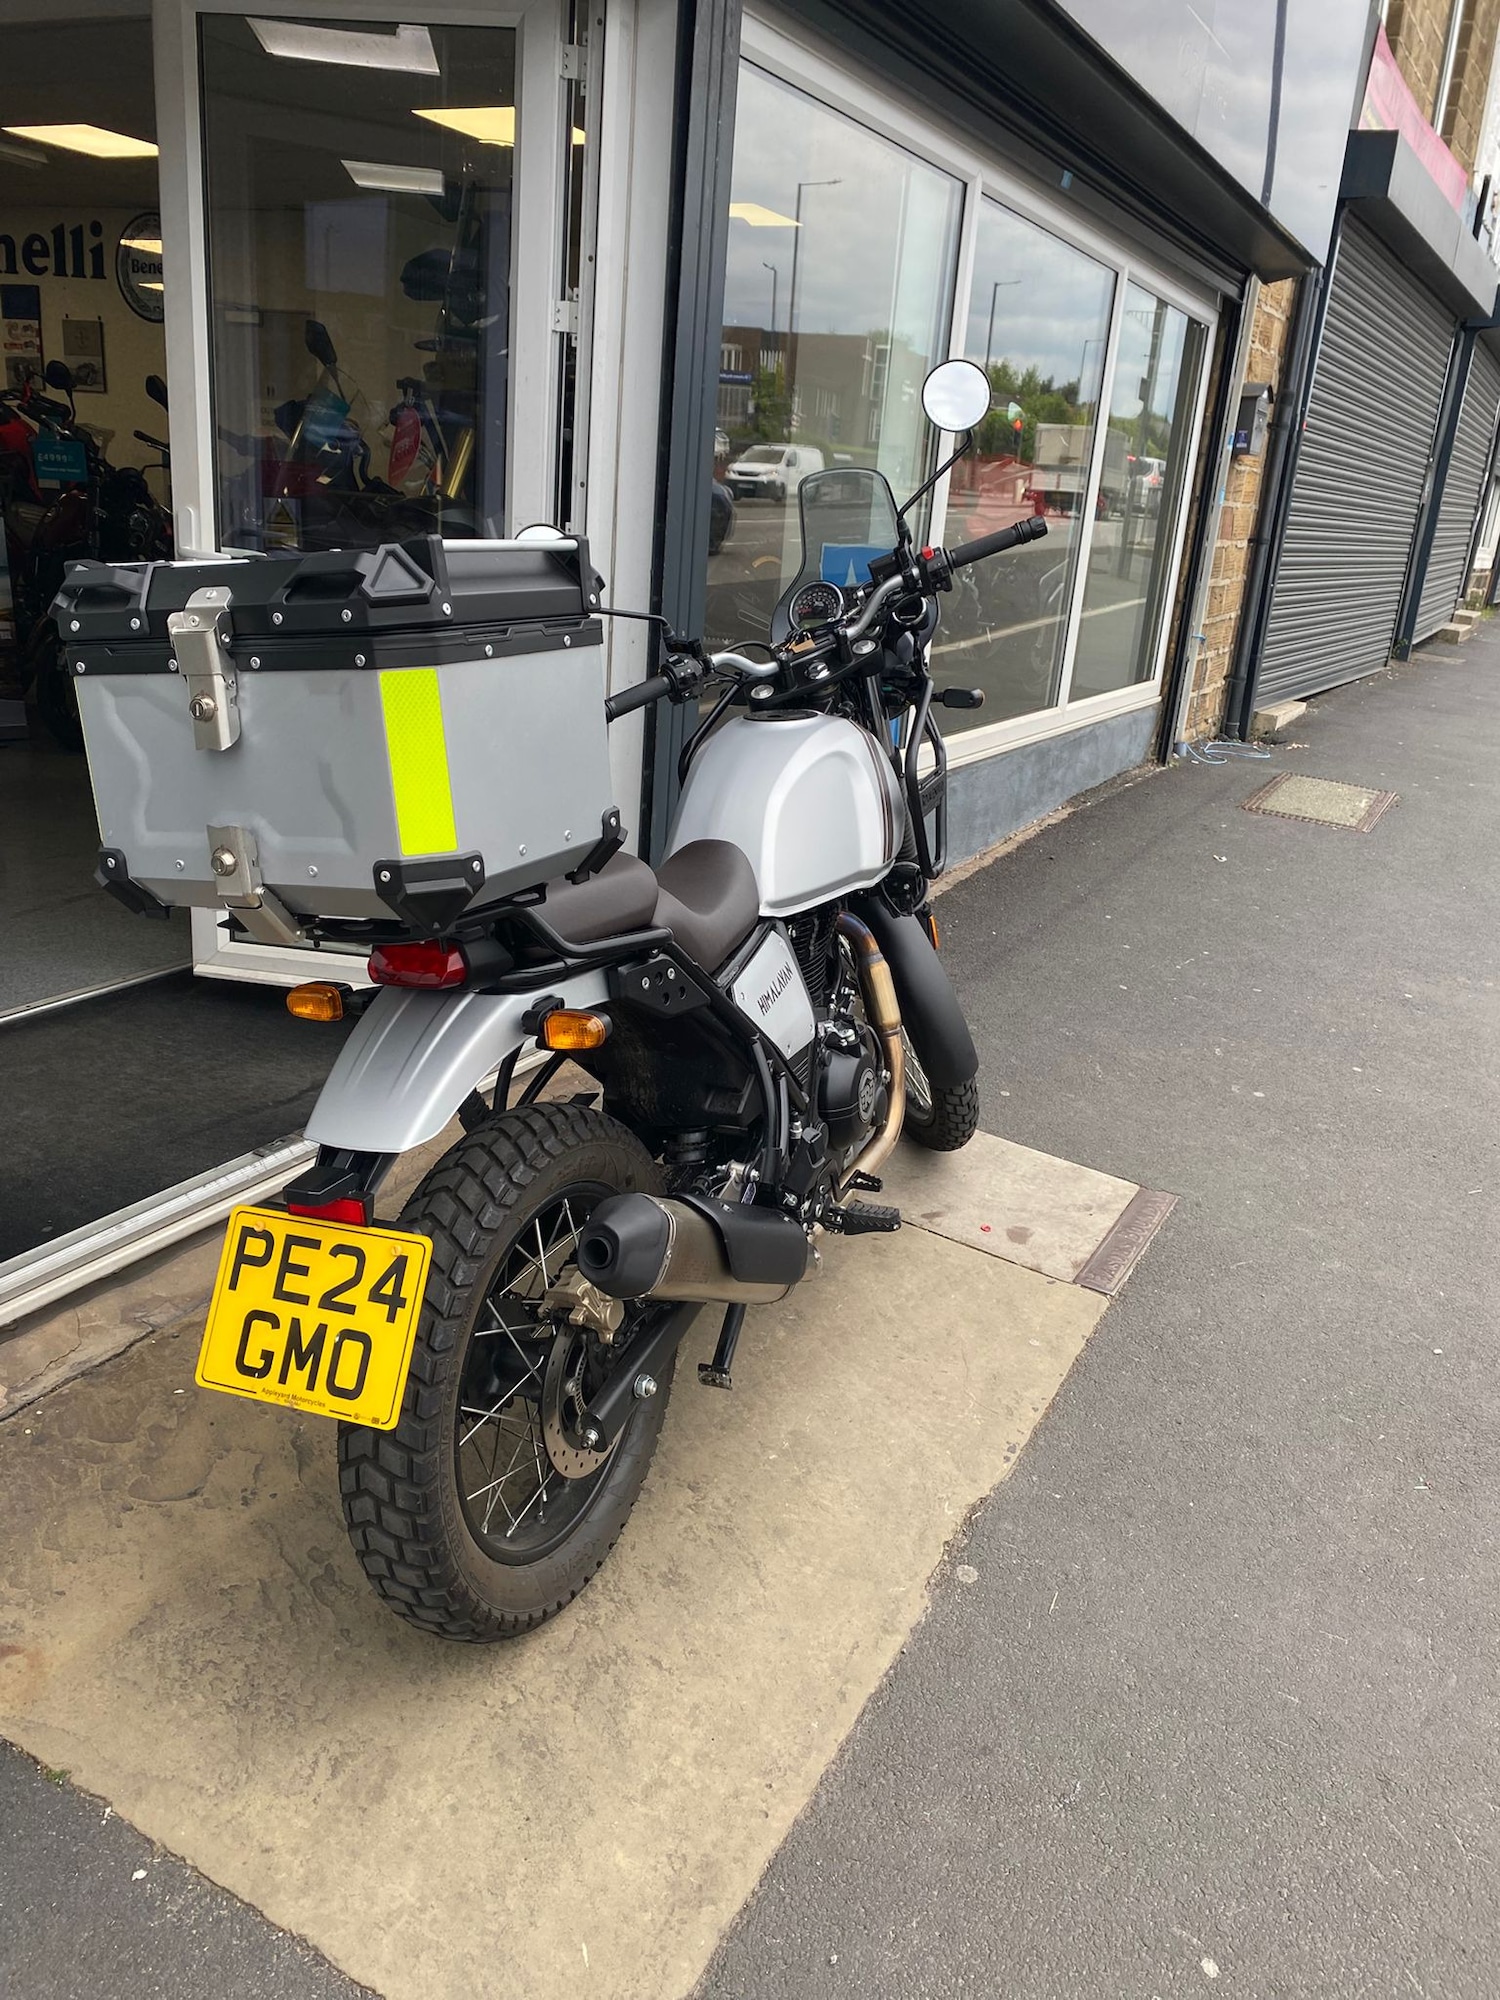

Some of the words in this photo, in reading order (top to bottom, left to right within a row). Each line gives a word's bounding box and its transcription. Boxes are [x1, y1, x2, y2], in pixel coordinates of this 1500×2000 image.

[757, 961, 794, 1016] HIMALAYAN
[228, 1225, 408, 1324] PE24
[235, 1309, 372, 1401] GMO
[262, 1387, 291, 1400] Appleyard
[291, 1394, 326, 1408] Motorcycles
